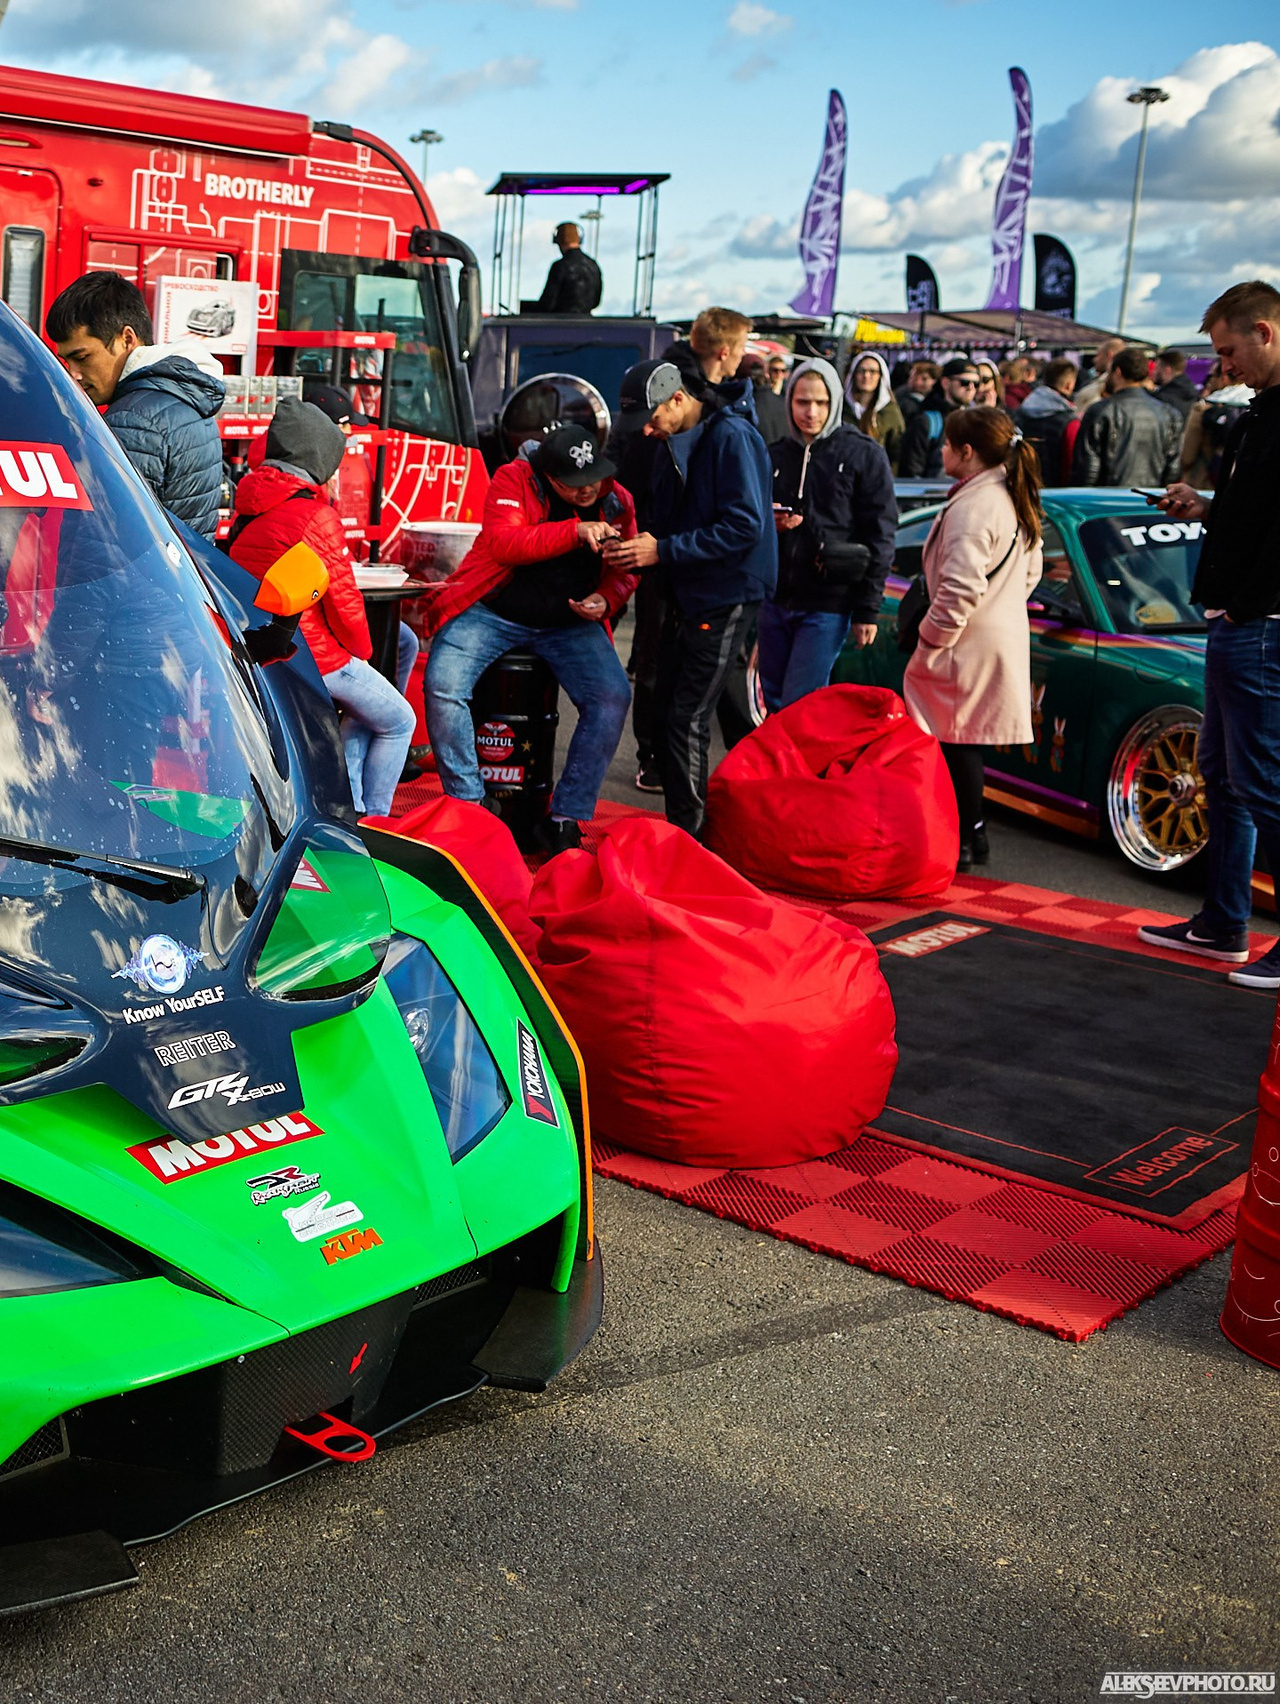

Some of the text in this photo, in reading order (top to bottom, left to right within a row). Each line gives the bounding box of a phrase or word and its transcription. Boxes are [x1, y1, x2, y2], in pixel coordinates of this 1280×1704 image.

[204, 173, 315, 208] BROTHERLY
[1120, 522, 1207, 546] TOY
[477, 736, 514, 747] MOTUL
[480, 766, 521, 781] OTUL
[886, 923, 981, 955] MOTUL
[122, 986, 225, 1024] Know YourSELF
[154, 1030, 236, 1067] REITER
[521, 1029, 546, 1099] YOKOHAMA
[1108, 1136, 1214, 1186] Welcome
[320, 1228, 384, 1266] KTM
